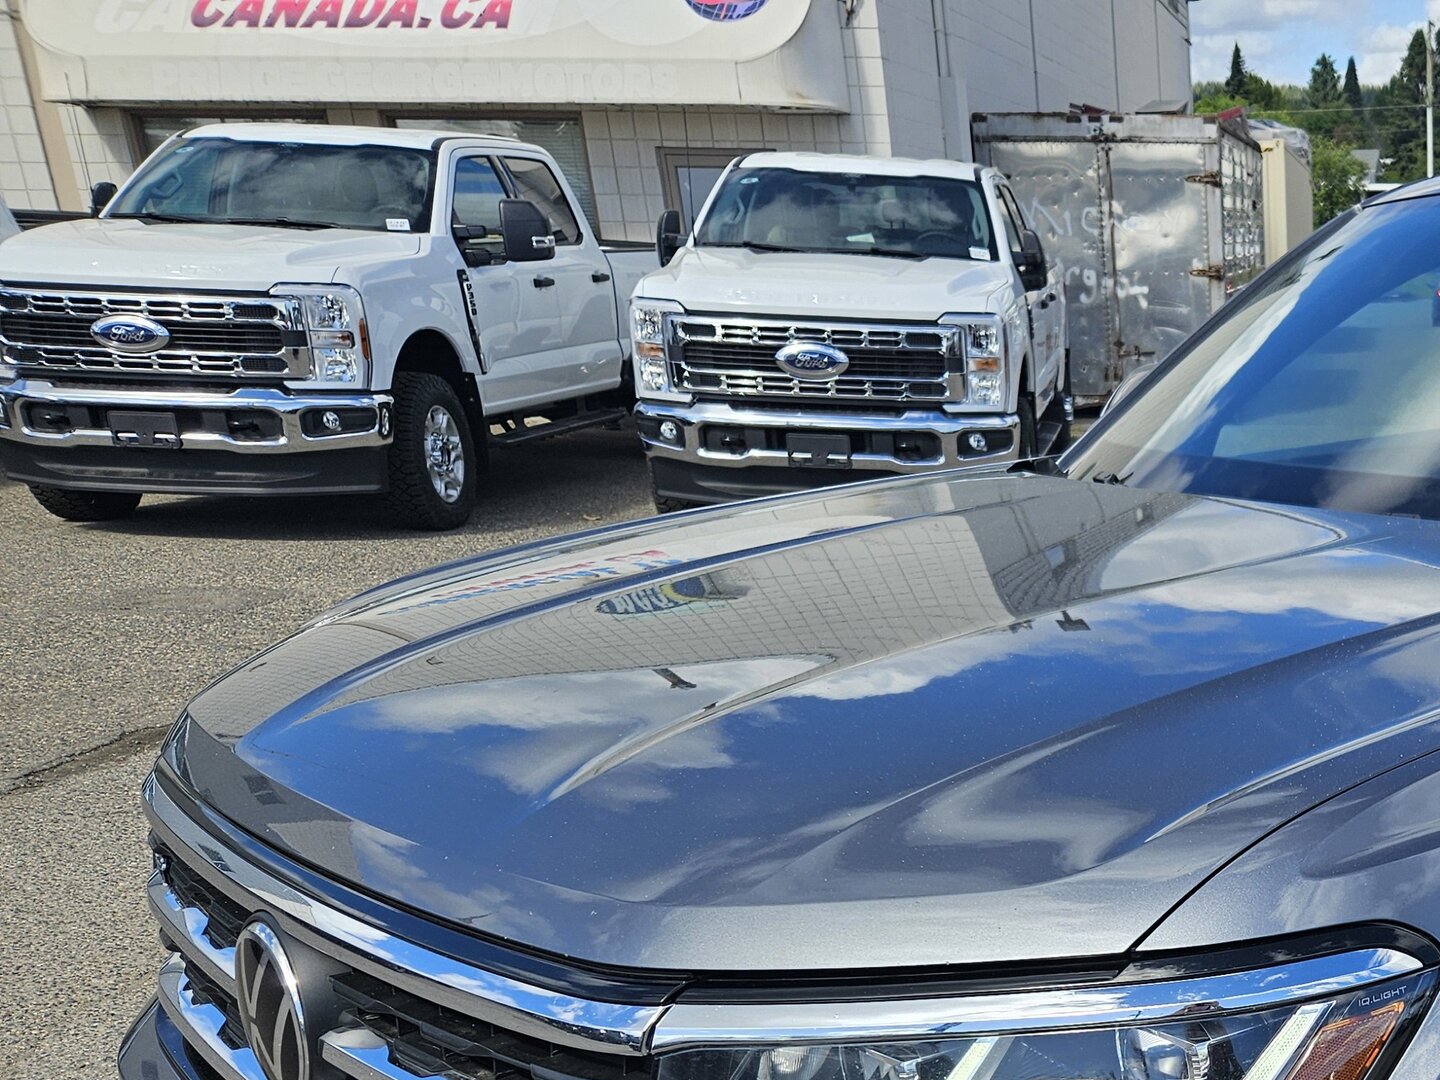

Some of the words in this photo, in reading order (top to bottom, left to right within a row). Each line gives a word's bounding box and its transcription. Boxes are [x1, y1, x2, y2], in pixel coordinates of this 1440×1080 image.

[189, 0, 511, 29] CANADA.CA
[109, 325, 145, 342] Ford
[795, 353, 829, 369] Ford
[1358, 985, 1407, 1008] IQ.LIGHT
